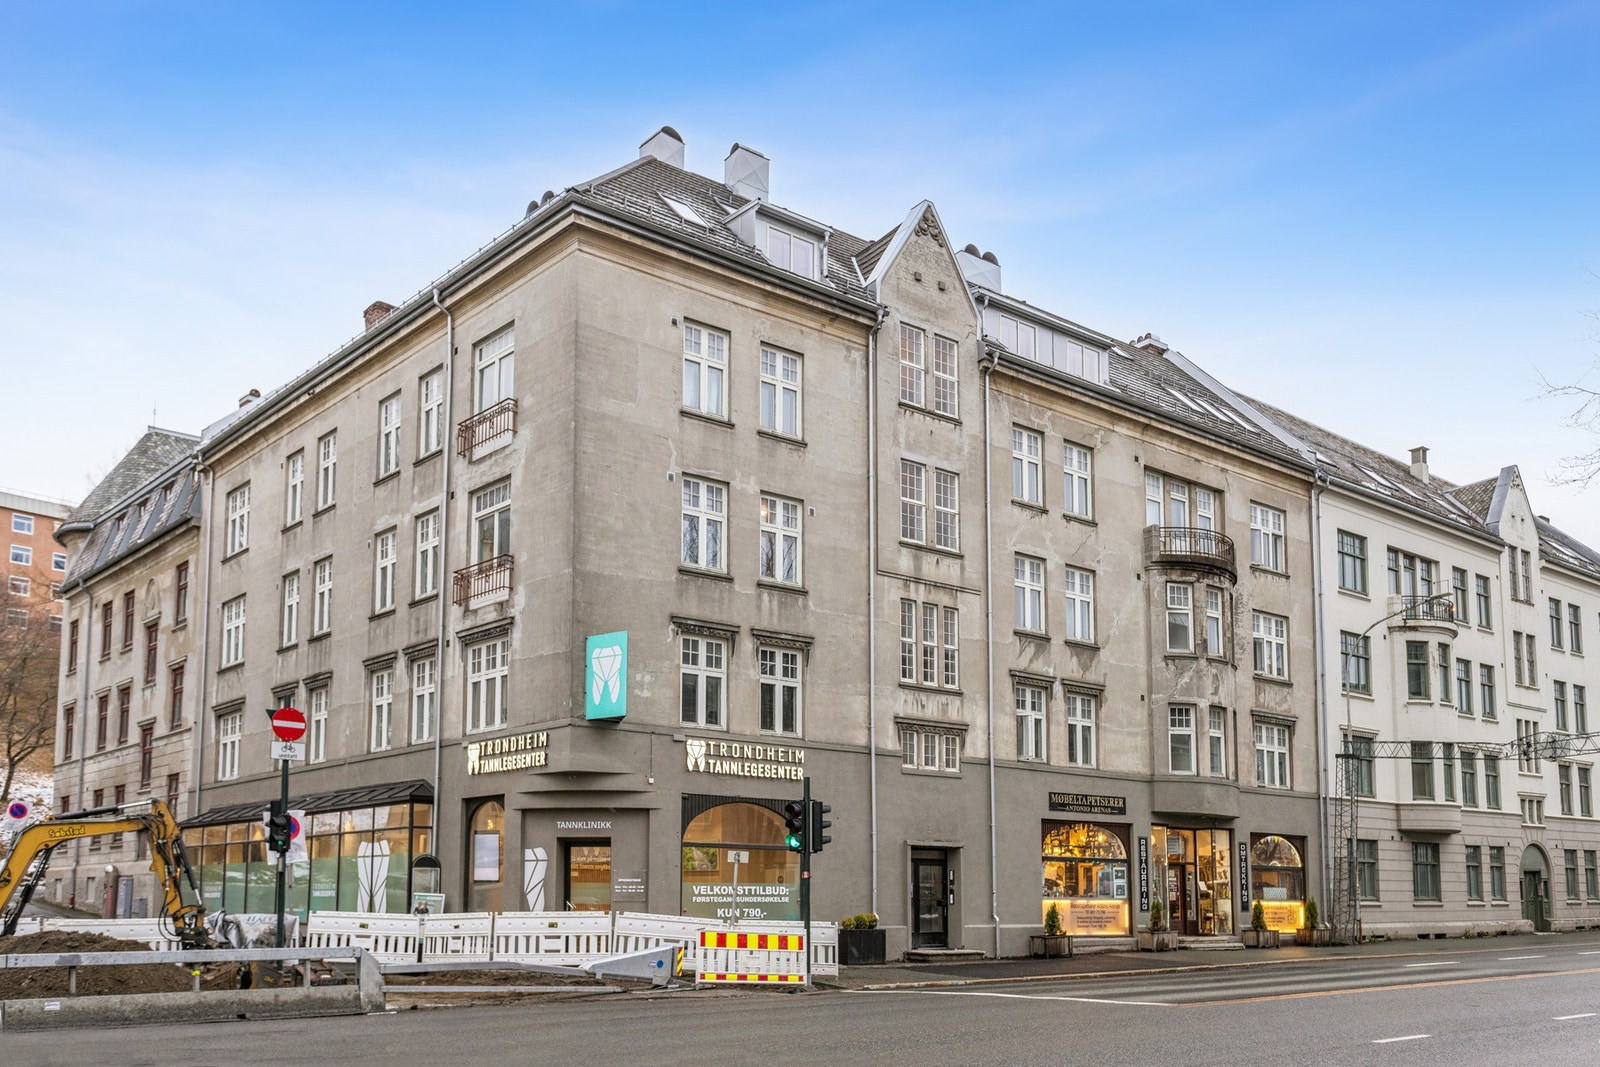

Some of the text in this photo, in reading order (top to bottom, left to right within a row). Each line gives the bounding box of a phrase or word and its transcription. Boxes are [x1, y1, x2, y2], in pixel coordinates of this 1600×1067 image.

[480, 732, 548, 757] TRONDHEIM
[708, 741, 805, 764] TRONDHEIM
[480, 751, 546, 774] TANNLEGESENTER
[708, 759, 804, 780] TANNLEGESENTER
[1051, 793, 1124, 807] MØBELTAPETSERER
[557, 821, 612, 829] TANNKLINIKK
[1140, 839, 1148, 910] RESTAURERING
[1240, 844, 1248, 902] OMTREKKING
[717, 908, 767, 919] KUN 790,-
